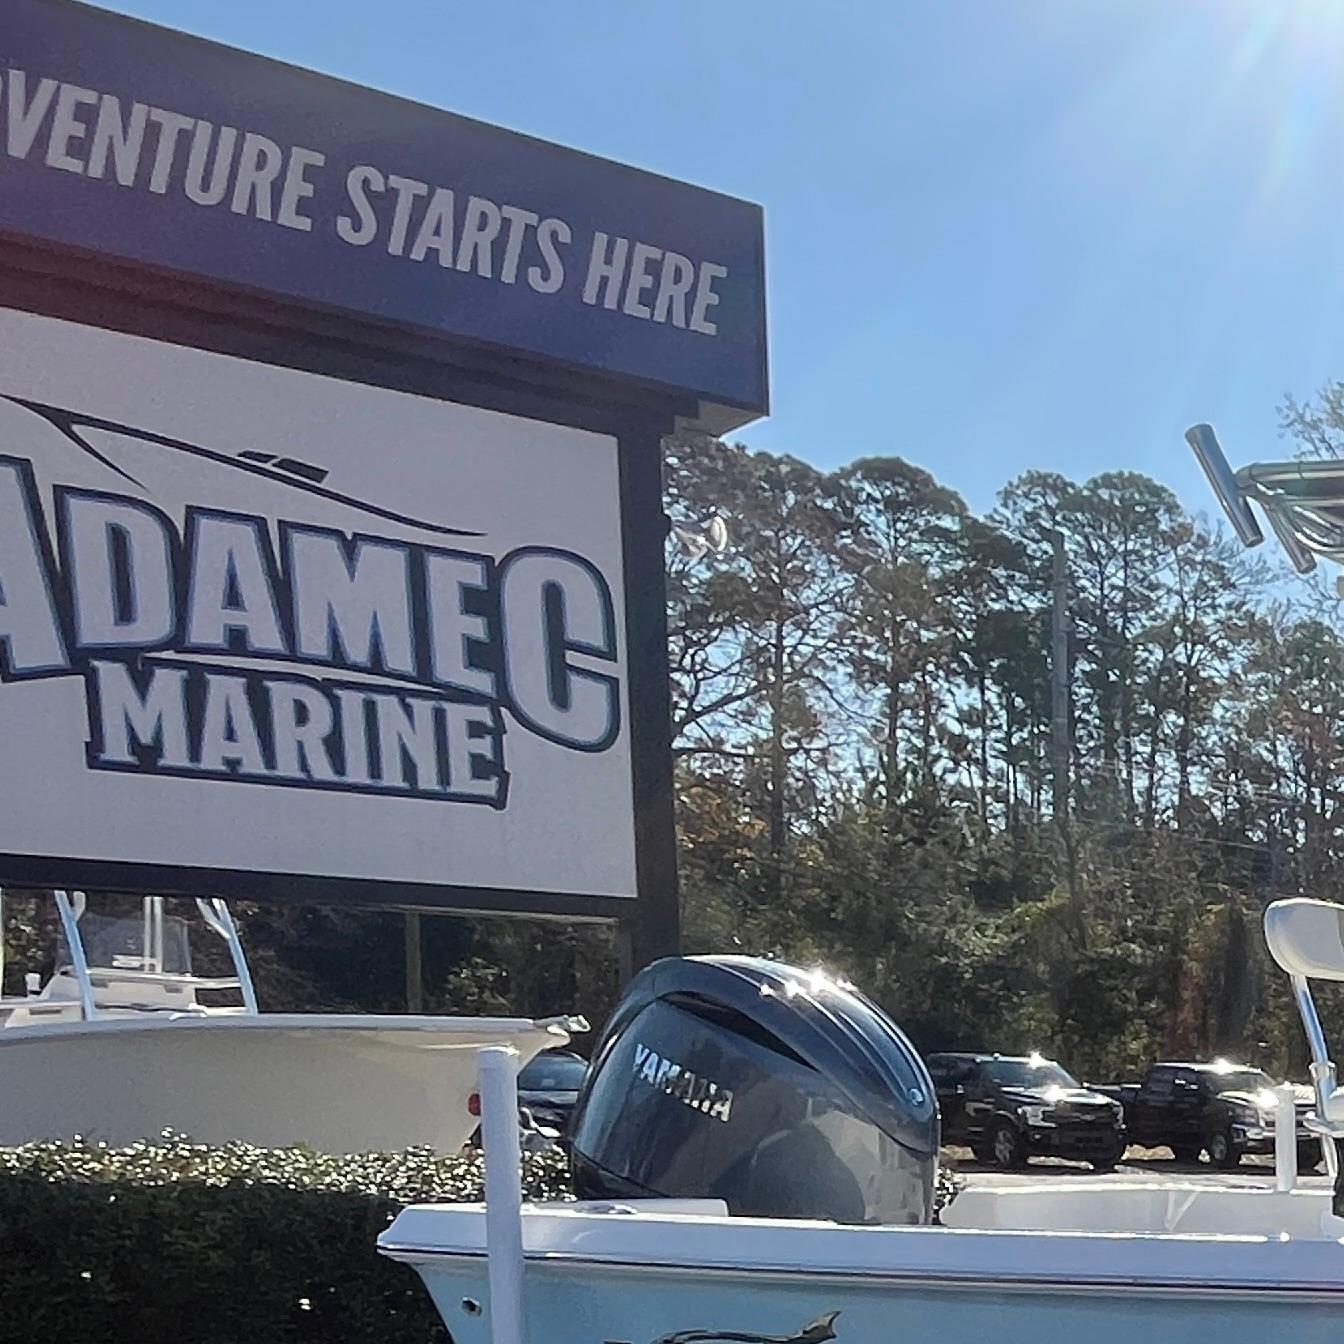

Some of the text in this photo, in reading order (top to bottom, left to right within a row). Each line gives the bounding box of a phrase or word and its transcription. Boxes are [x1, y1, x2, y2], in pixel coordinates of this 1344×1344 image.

[0, 68, 729, 336] VENTURE STARTS HERE
[86, 656, 510, 811] MARINE
[632, 1042, 734, 1123] YAMAHA
